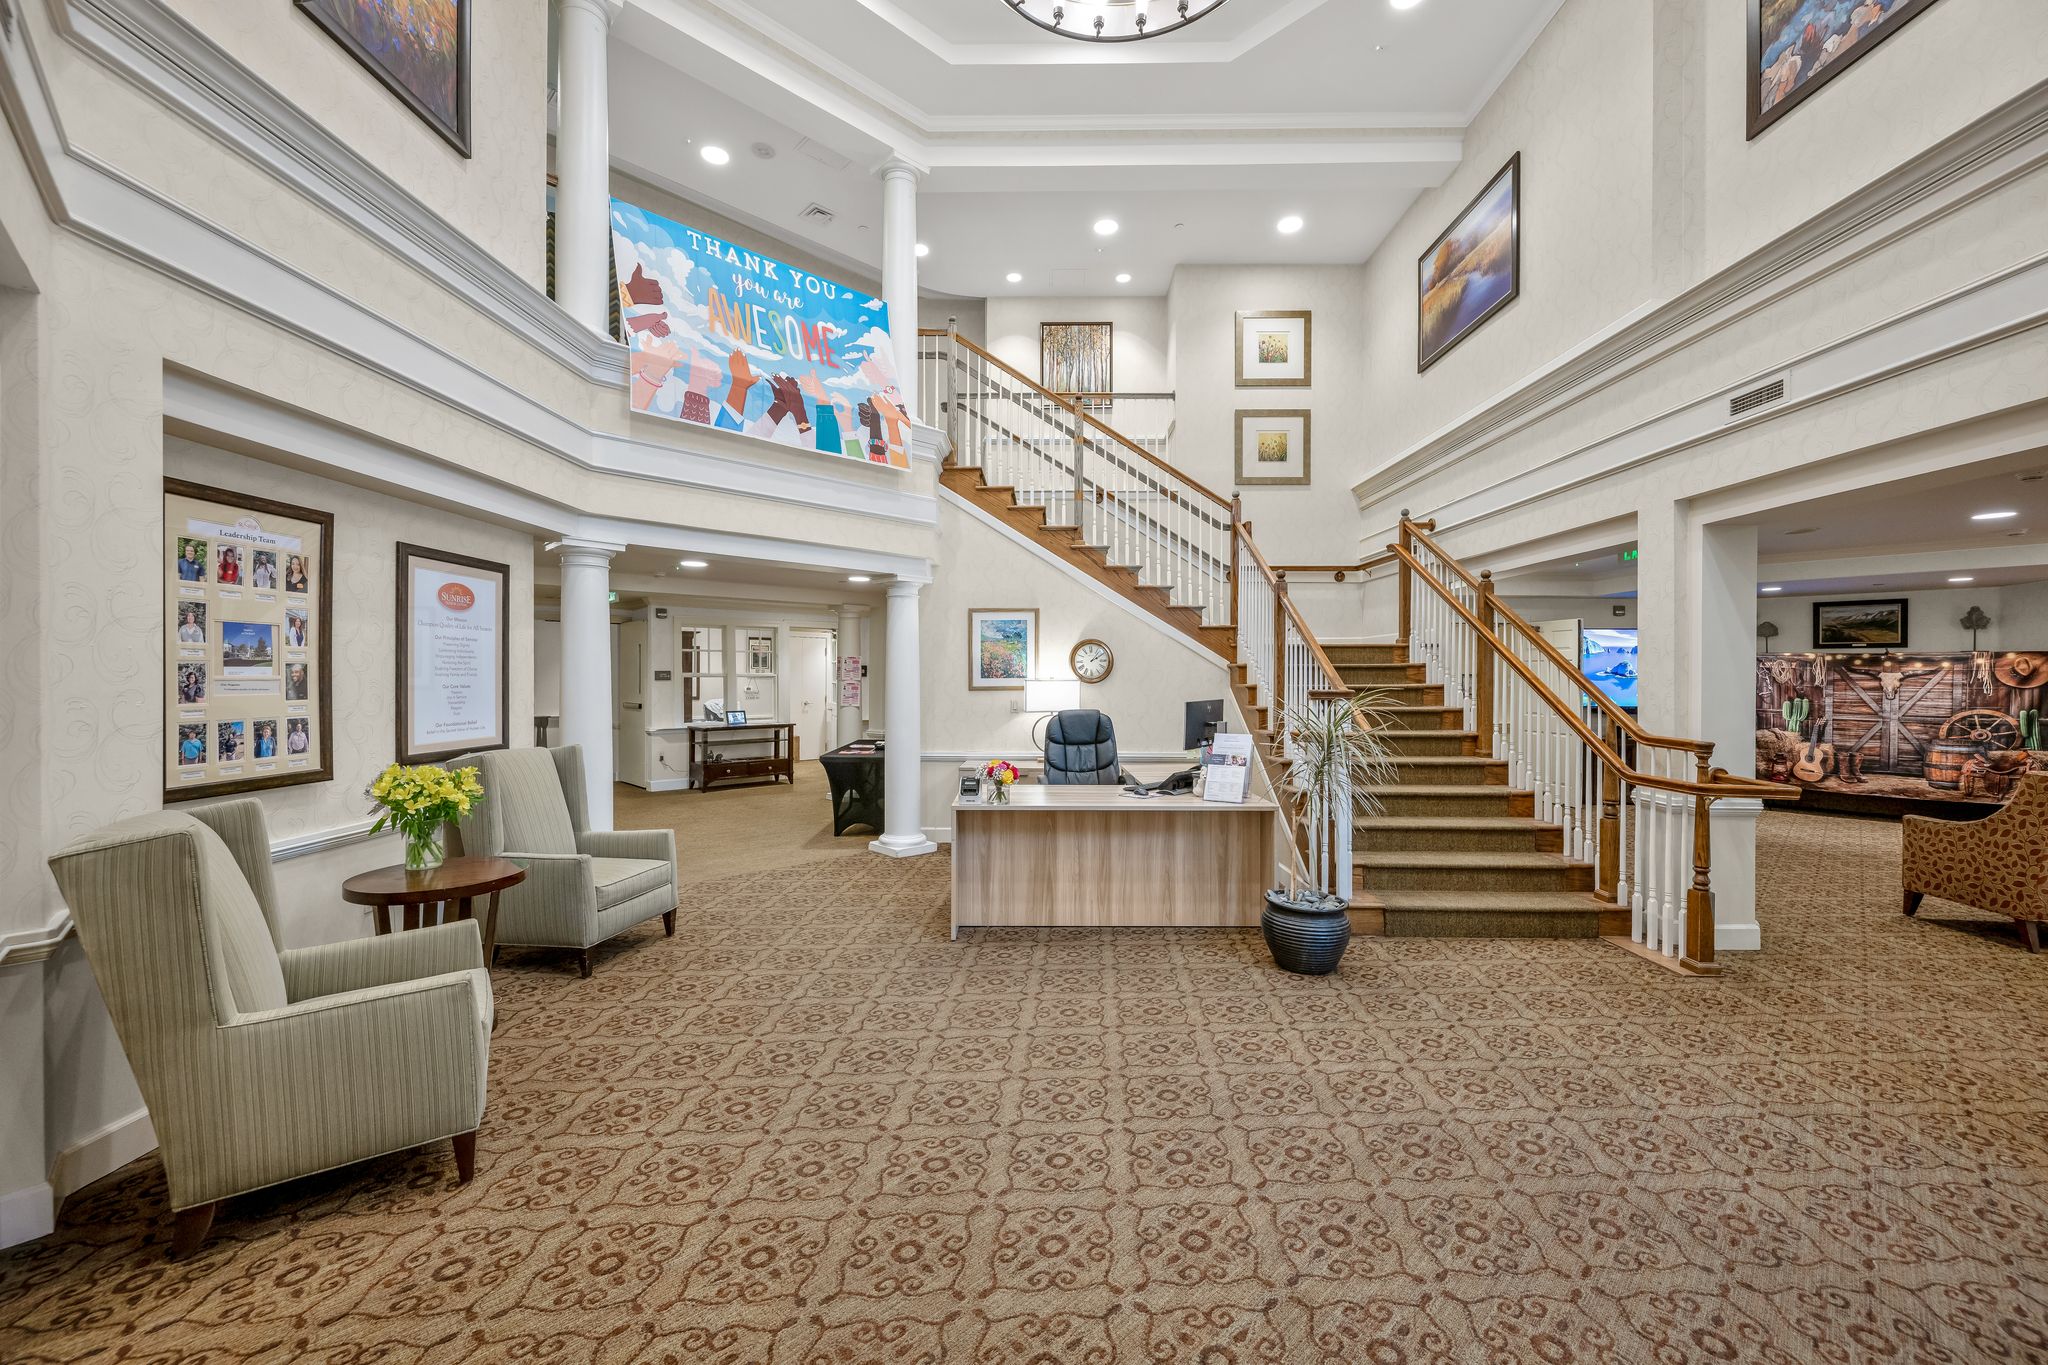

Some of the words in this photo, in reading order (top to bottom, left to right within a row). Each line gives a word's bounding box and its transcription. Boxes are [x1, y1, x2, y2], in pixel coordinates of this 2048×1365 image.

[686, 230, 779, 281] THANK
[789, 269, 837, 300] YOU
[732, 272, 769, 298] you
[773, 289, 804, 310] are
[708, 287, 841, 369] AWESOME
[219, 529, 258, 543] Leadership
[257, 535, 276, 545] Team
[441, 591, 472, 604] SUNRISE
